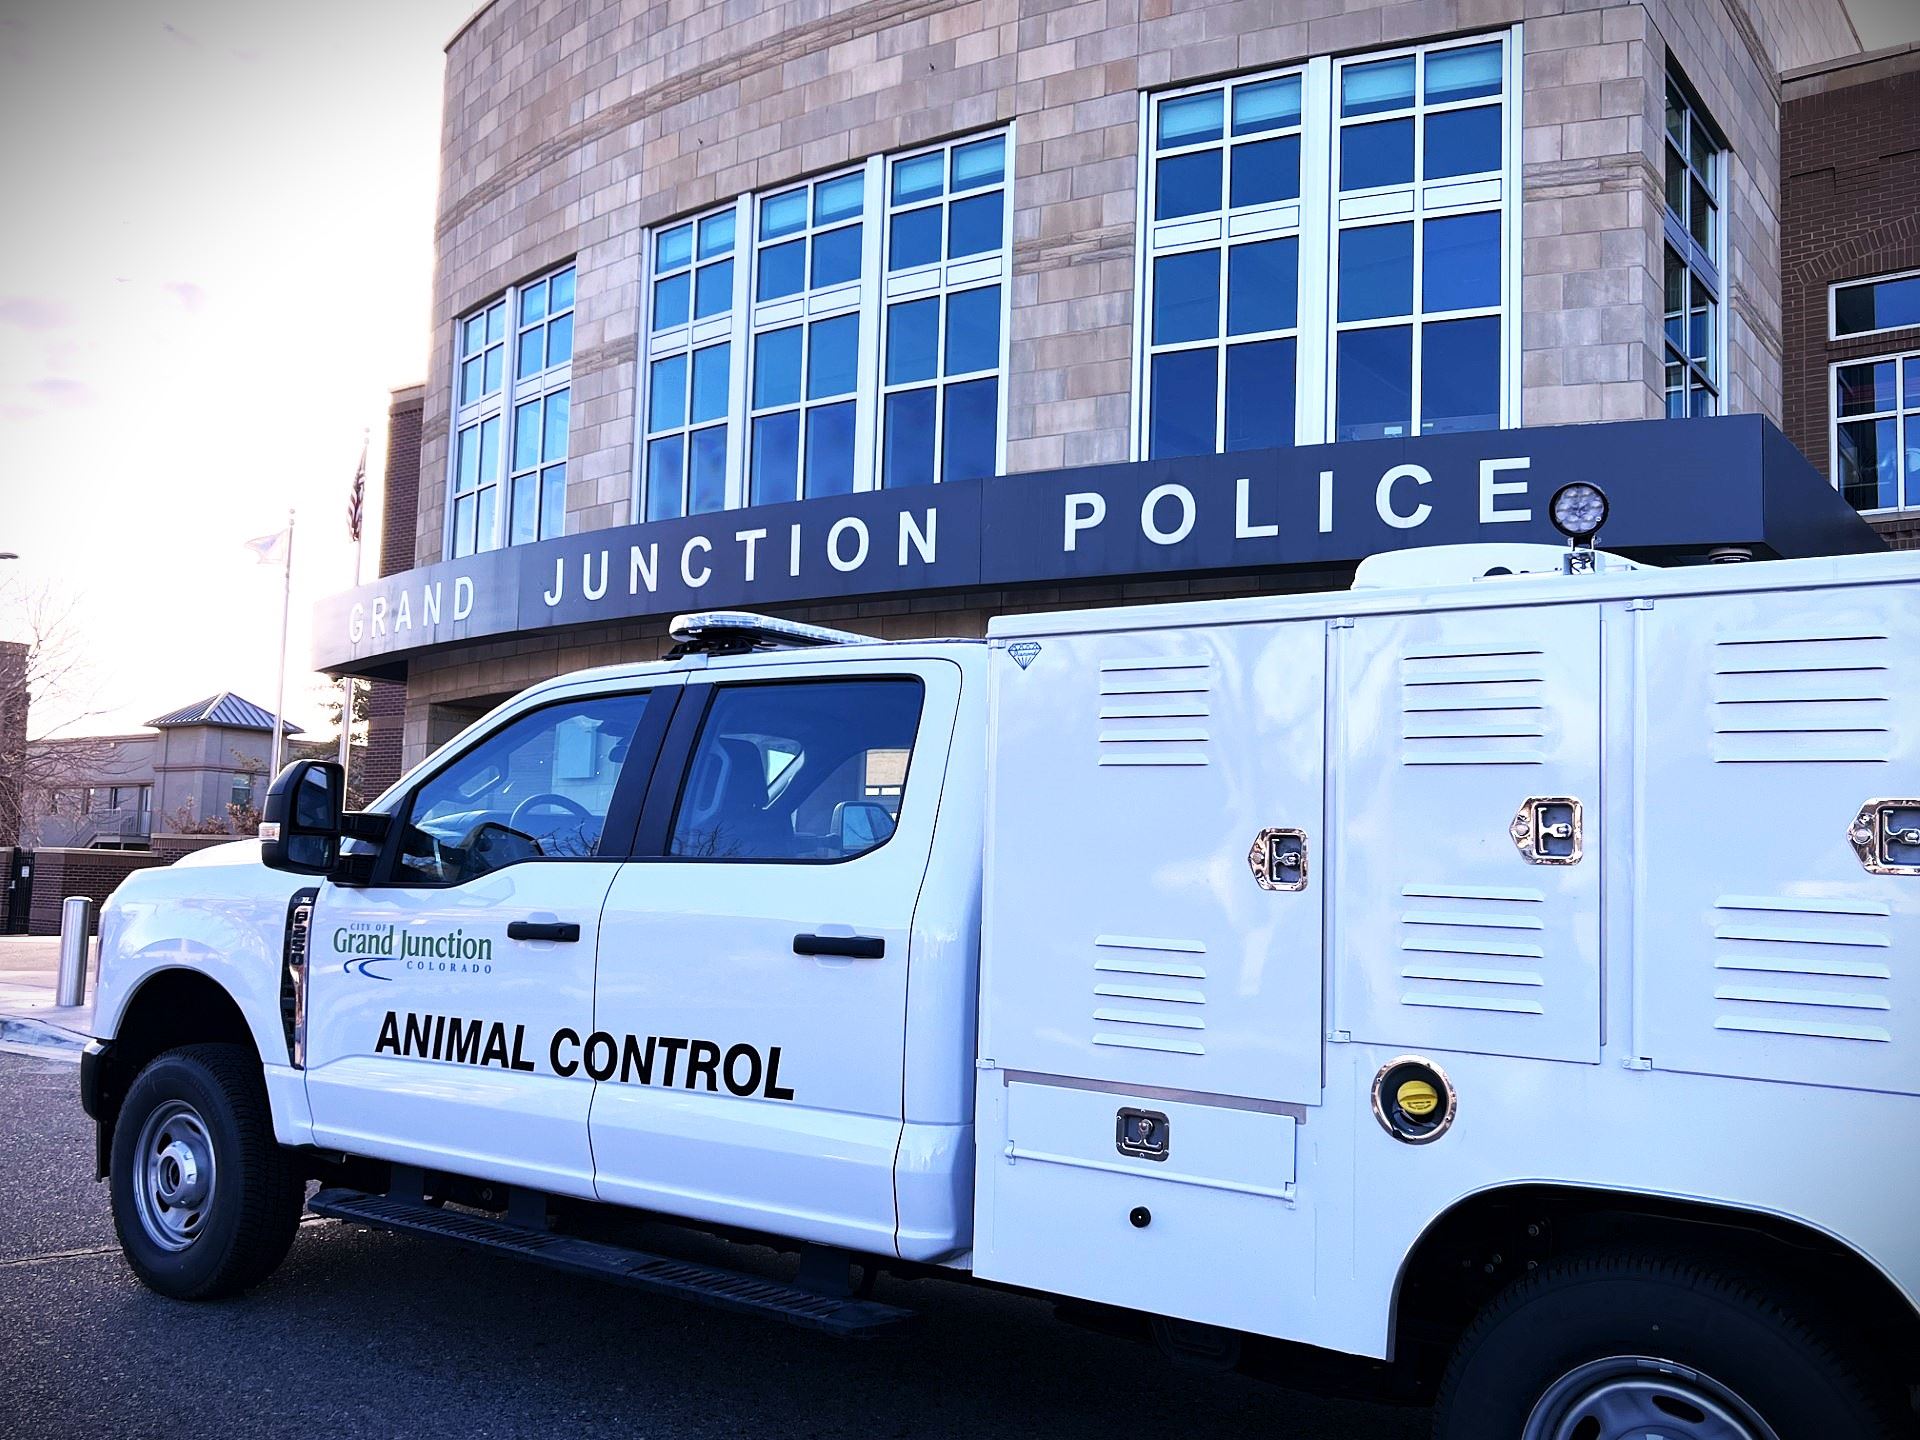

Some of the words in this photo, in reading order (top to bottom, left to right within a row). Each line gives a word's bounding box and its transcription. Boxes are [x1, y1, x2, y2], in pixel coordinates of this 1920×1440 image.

[350, 576, 475, 643] GRAND
[543, 507, 937, 607] JUNCTION
[1063, 457, 1532, 552] POLICE
[333, 925, 395, 955] Grand
[400, 928, 493, 961] Junction
[350, 923, 371, 931] CITY
[375, 924, 388, 932] OF
[406, 960, 493, 974] COLORADO
[375, 1011, 536, 1072] ANIMAL
[549, 1027, 795, 1101] CONTROL
